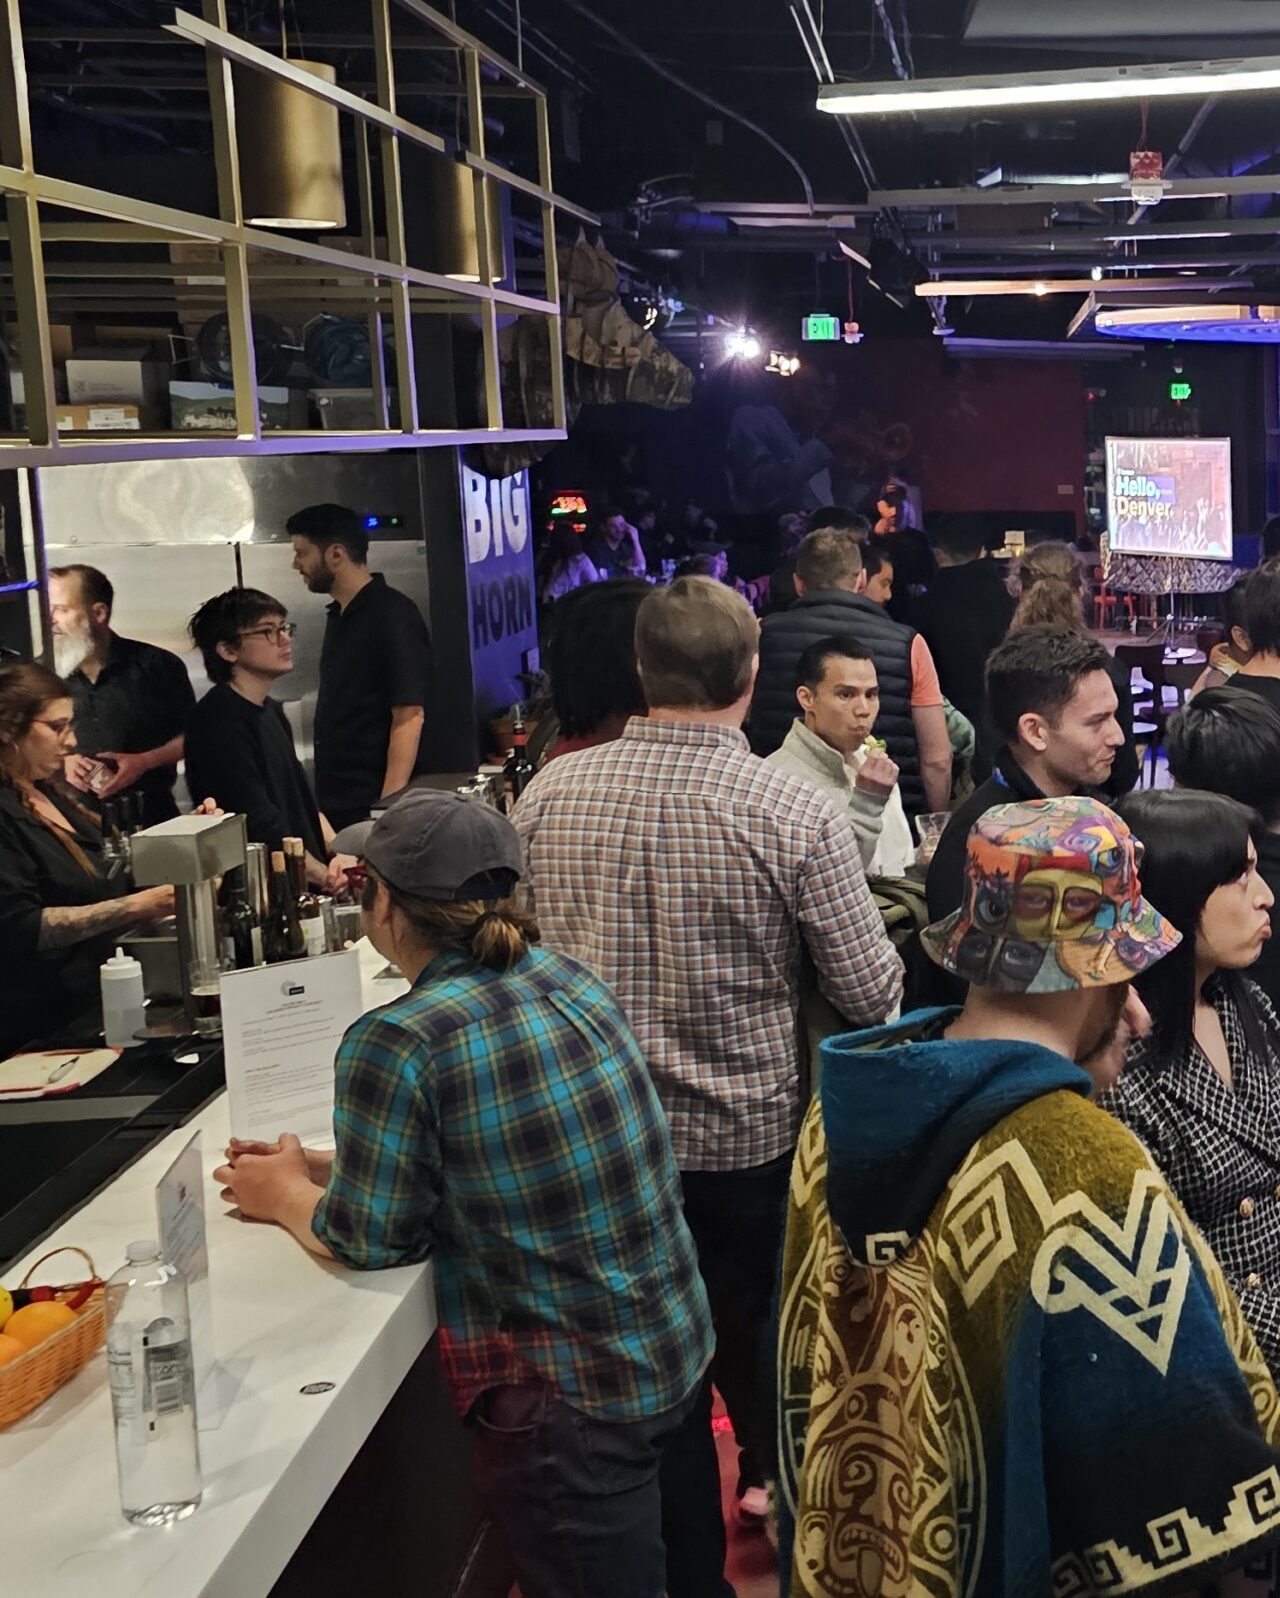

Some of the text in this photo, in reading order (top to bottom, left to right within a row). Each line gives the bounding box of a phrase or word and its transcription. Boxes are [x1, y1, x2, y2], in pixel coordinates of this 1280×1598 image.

[1115, 475, 1161, 500] Hello,
[1117, 497, 1174, 517] Denver.
[463, 465, 528, 564] BIG
[472, 573, 532, 649] HORN
